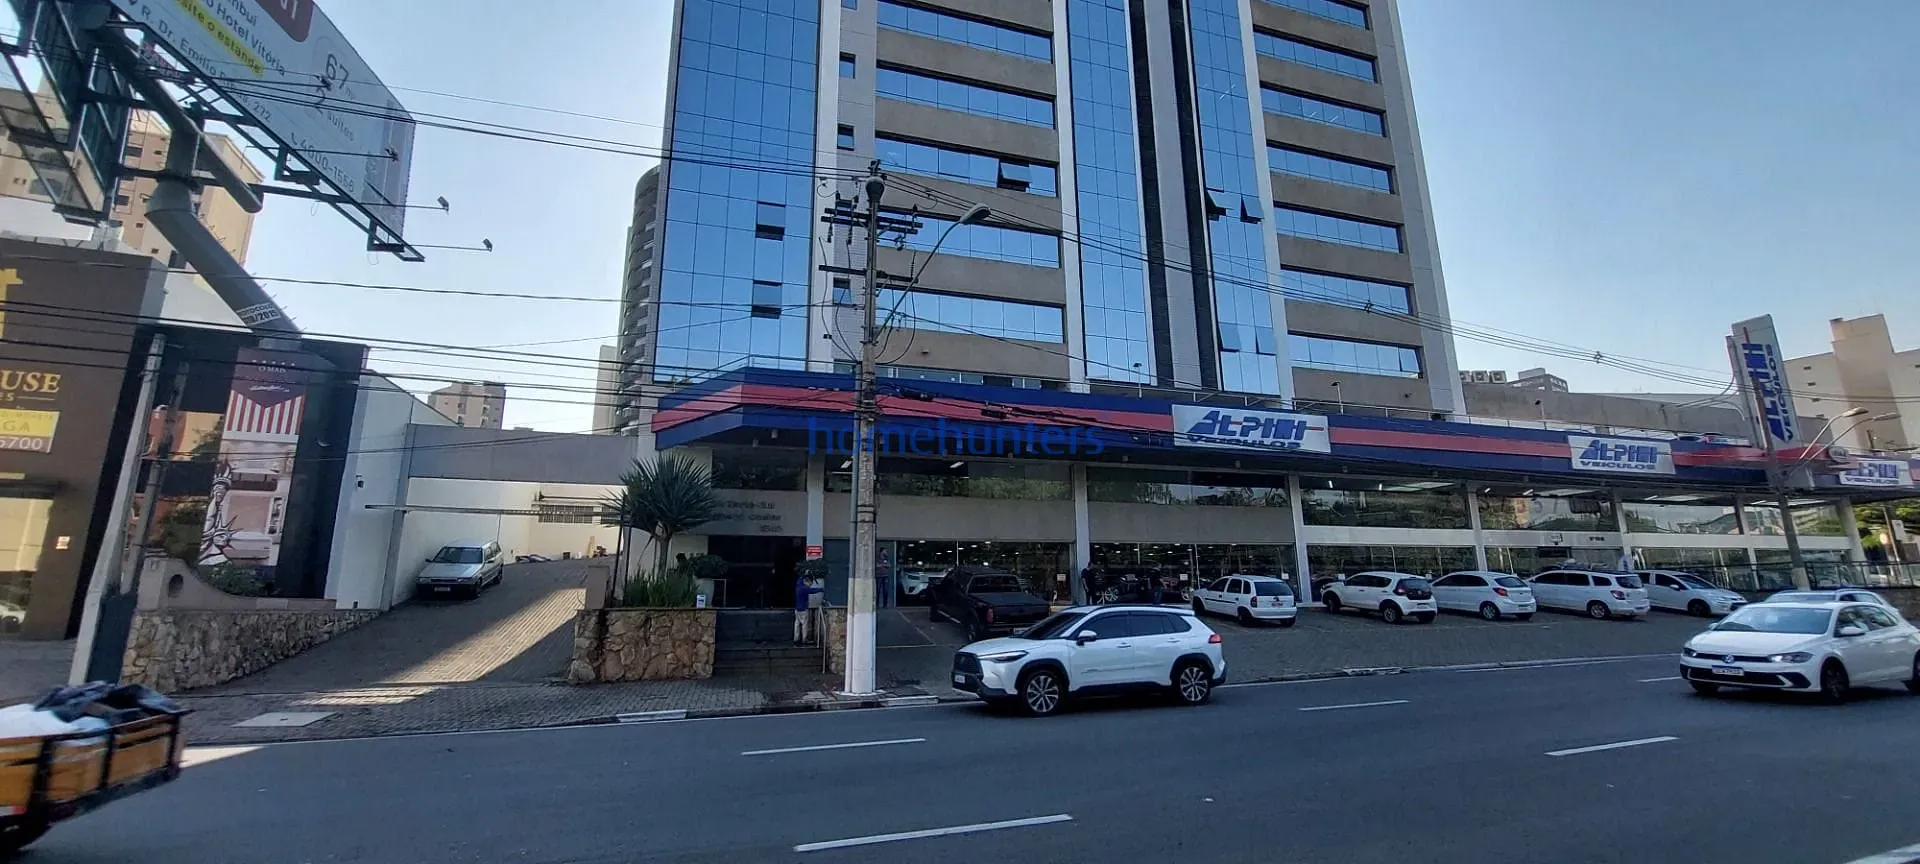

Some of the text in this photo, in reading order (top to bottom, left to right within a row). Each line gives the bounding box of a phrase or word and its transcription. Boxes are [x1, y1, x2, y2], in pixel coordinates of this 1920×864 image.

[141, 6, 153, 23] R.
[158, 20, 176, 42] Dr.
[207, 21, 215, 31] o
[217, 3, 249, 40] Hotel
[326, 53, 349, 90] 67
